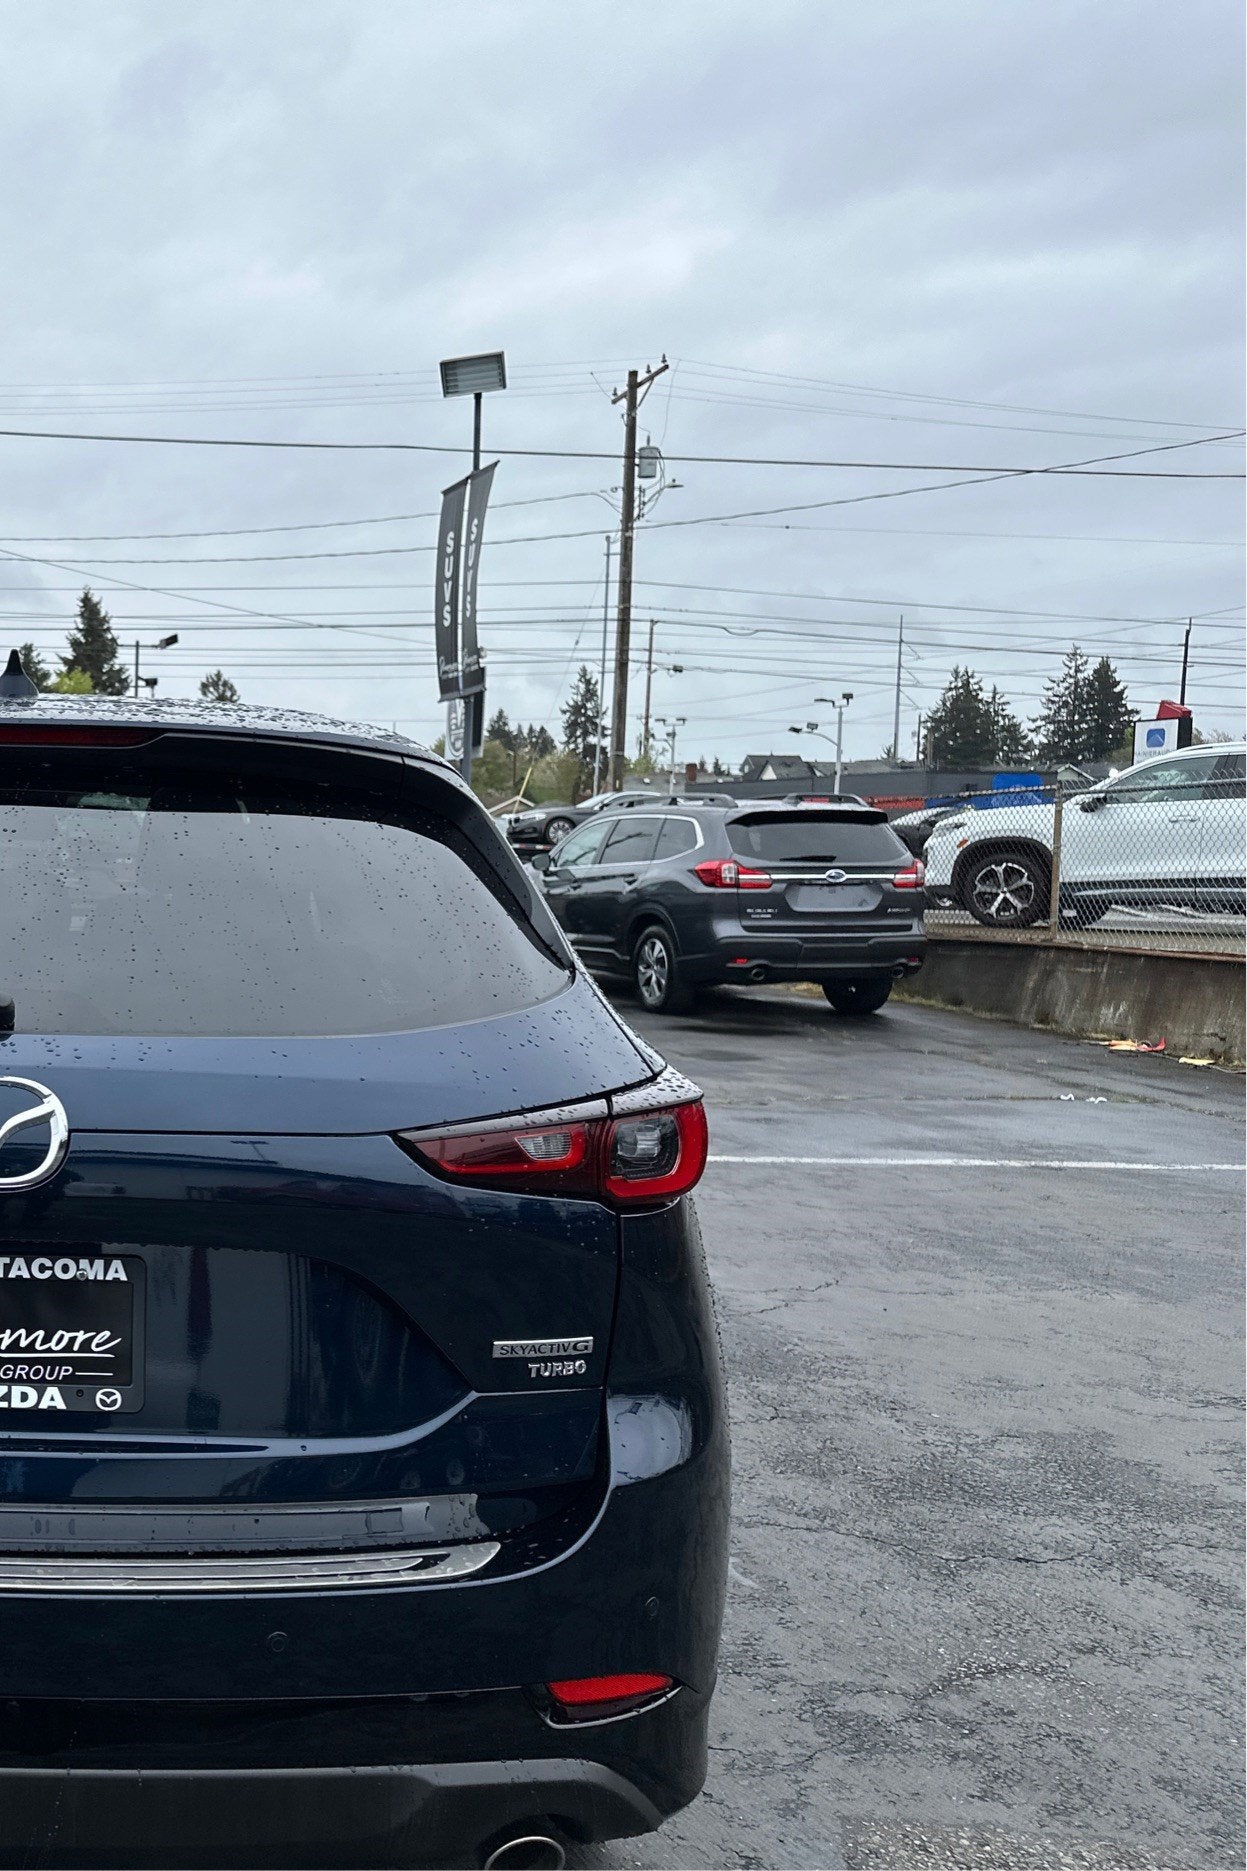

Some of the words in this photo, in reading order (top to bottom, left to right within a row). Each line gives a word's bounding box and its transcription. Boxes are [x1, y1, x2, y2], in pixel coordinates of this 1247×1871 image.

[442, 531, 455, 628] SUVS
[0, 1365, 73, 1381] GROUP
[528, 1360, 587, 1378] TURBO
